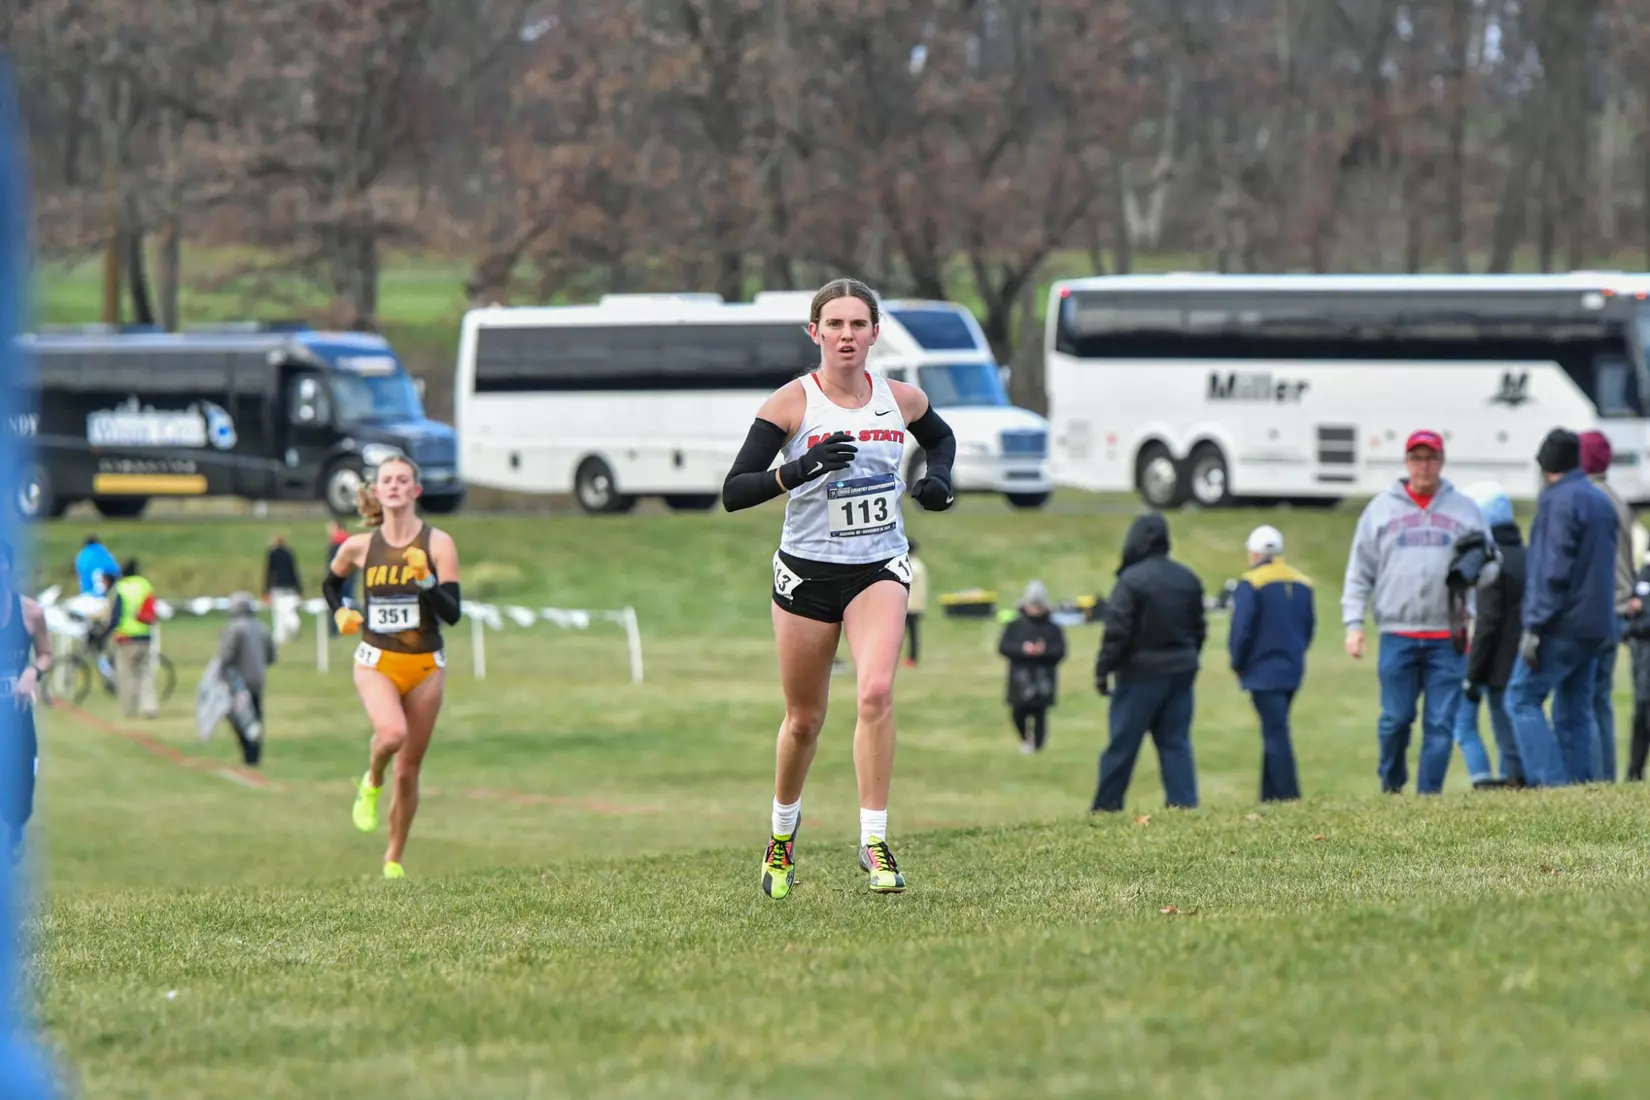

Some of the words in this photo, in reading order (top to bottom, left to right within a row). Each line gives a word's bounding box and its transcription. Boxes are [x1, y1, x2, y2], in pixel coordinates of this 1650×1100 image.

[1205, 370, 1310, 403] Miller
[807, 430, 856, 449] BAL
[858, 429, 904, 444] STATE
[841, 497, 888, 526] 113
[367, 565, 415, 587] VALP
[378, 608, 408, 624] 351
